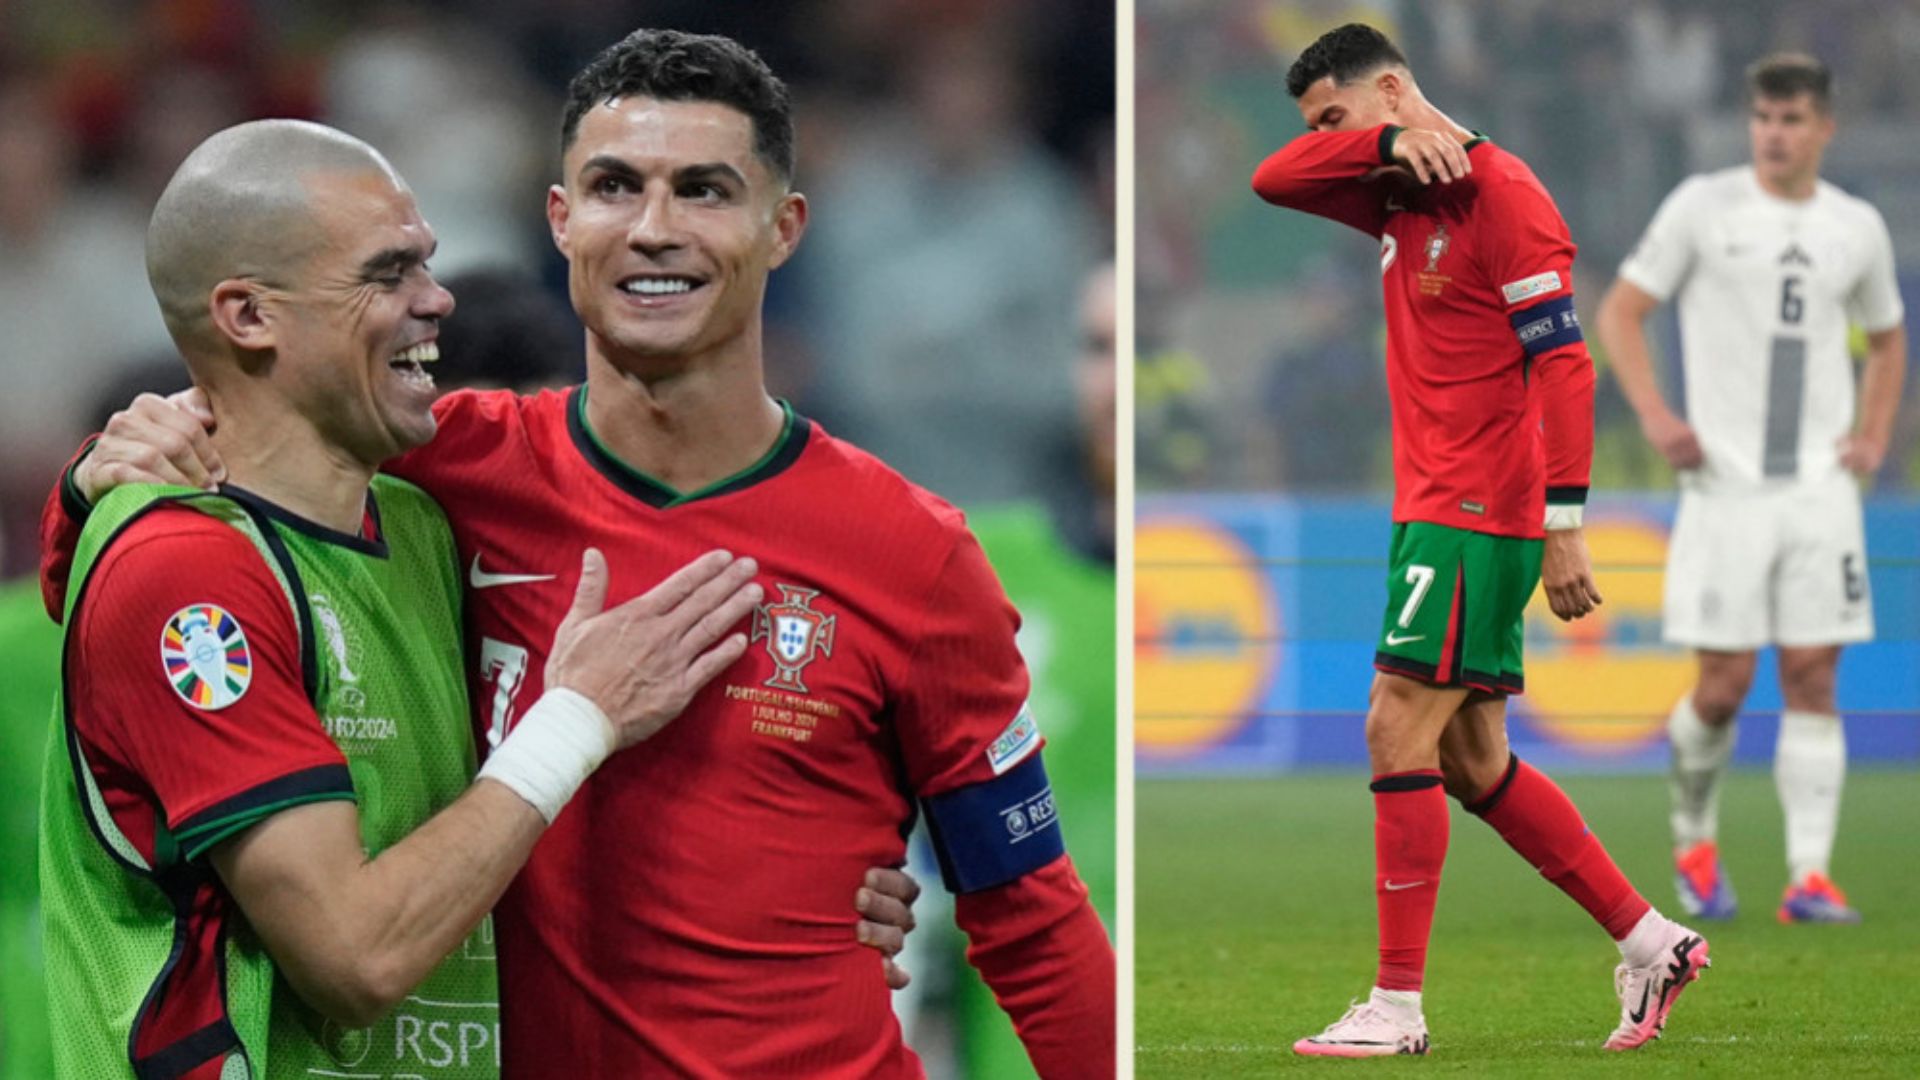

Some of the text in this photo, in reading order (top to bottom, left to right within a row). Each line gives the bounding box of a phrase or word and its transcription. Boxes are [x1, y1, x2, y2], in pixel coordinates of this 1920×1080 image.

[1781, 275, 1804, 324] 6
[1398, 564, 1436, 628] 7
[481, 636, 528, 751] 7
[752, 719, 813, 742] FRANKFURT
[1028, 798, 1055, 825] RES
